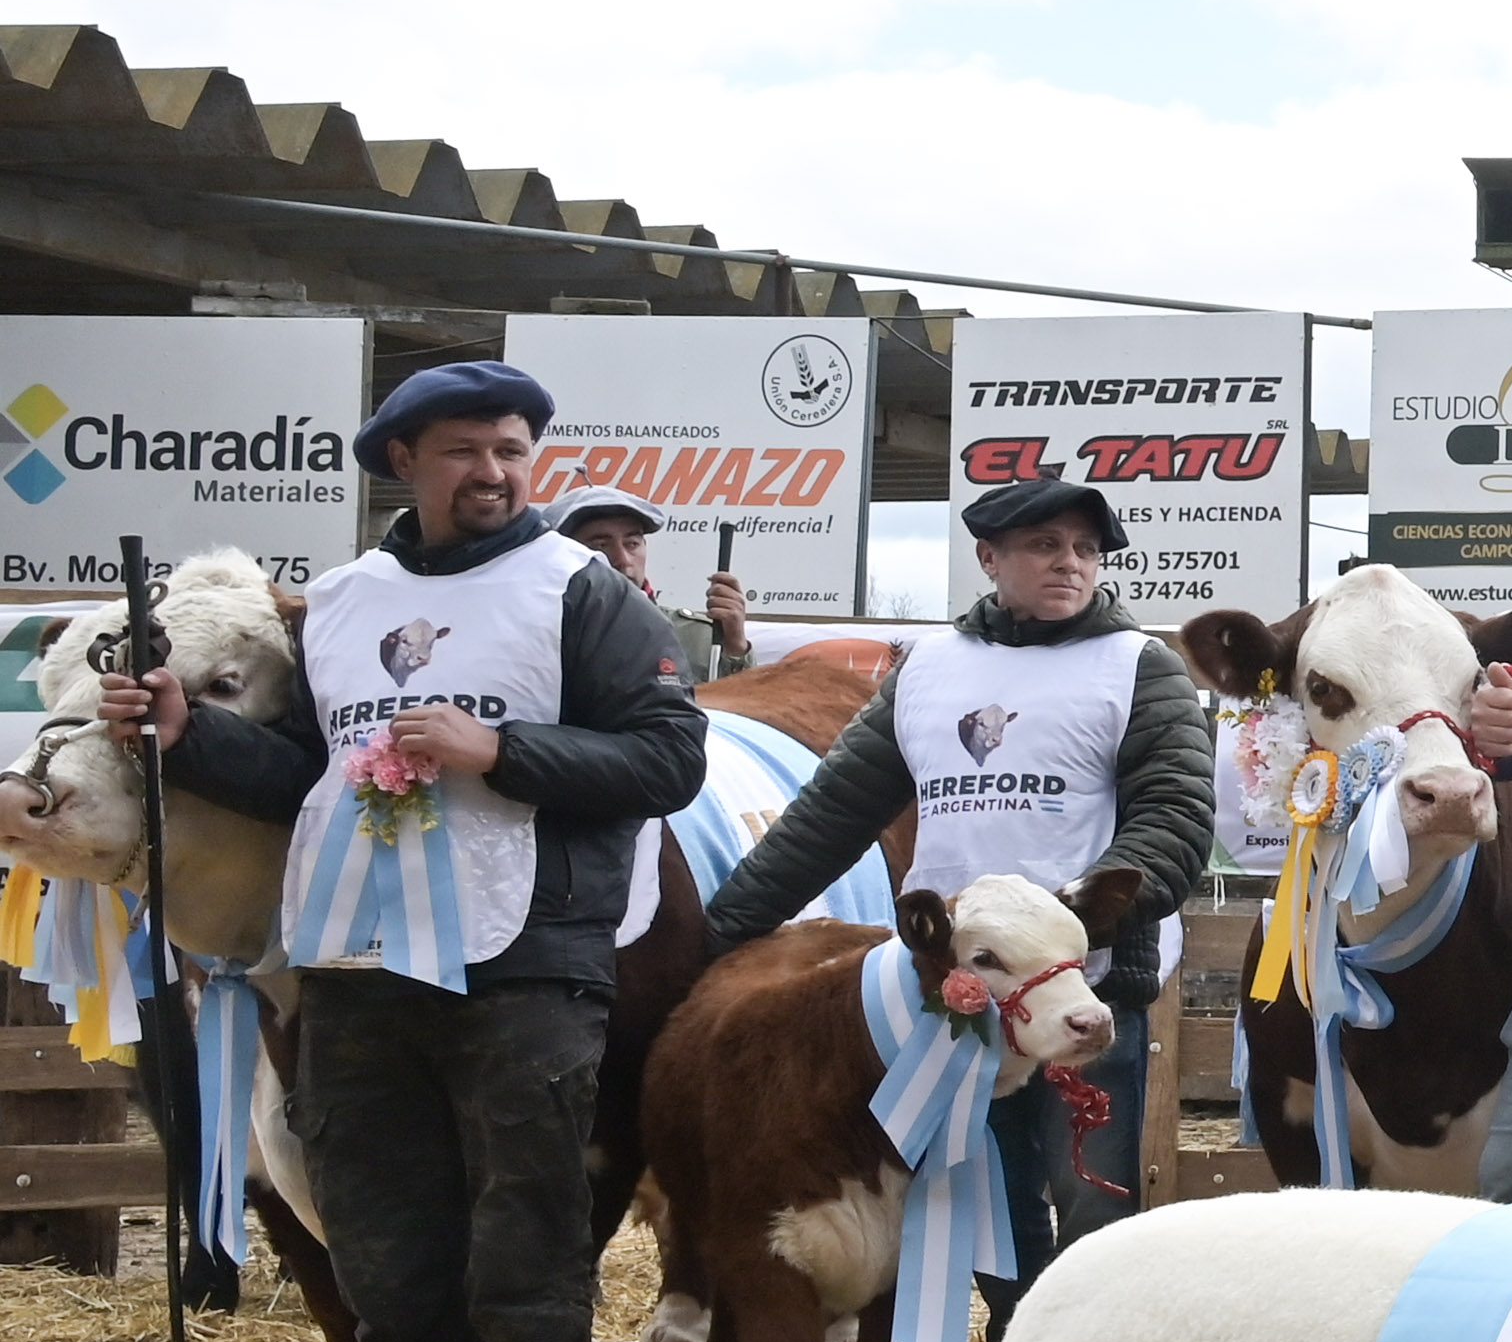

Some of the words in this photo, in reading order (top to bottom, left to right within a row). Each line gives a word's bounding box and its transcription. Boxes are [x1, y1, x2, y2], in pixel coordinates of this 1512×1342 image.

[771, 376, 788, 413] Unión
[791, 387, 842, 420] Cerealera
[968, 376, 1283, 408] TRANSPORTE
[1393, 395, 1499, 421] ESTUDIO
[615, 425, 720, 439] BALANCEADOS
[1266, 419, 1290, 430] SRL
[64, 414, 344, 472] Charadía
[961, 436, 1068, 485] EL
[1077, 433, 1286, 483] TATU
[528, 445, 846, 507] GRANAZO
[194, 479, 345, 503] Materiales
[666, 516, 708, 533] hace
[1160, 507, 1171, 522] Y
[1178, 506, 1282, 522] HACIENDA
[1393, 524, 1464, 540] CIENCIAS
[3, 555, 55, 583] Bv.
[1157, 550, 1241, 571] 575701
[763, 590, 840, 604] granazo.uc
[1129, 580, 1214, 600] 374746
[920, 773, 1066, 804] HEREFORD
[931, 798, 1033, 817] ARGENTINA
